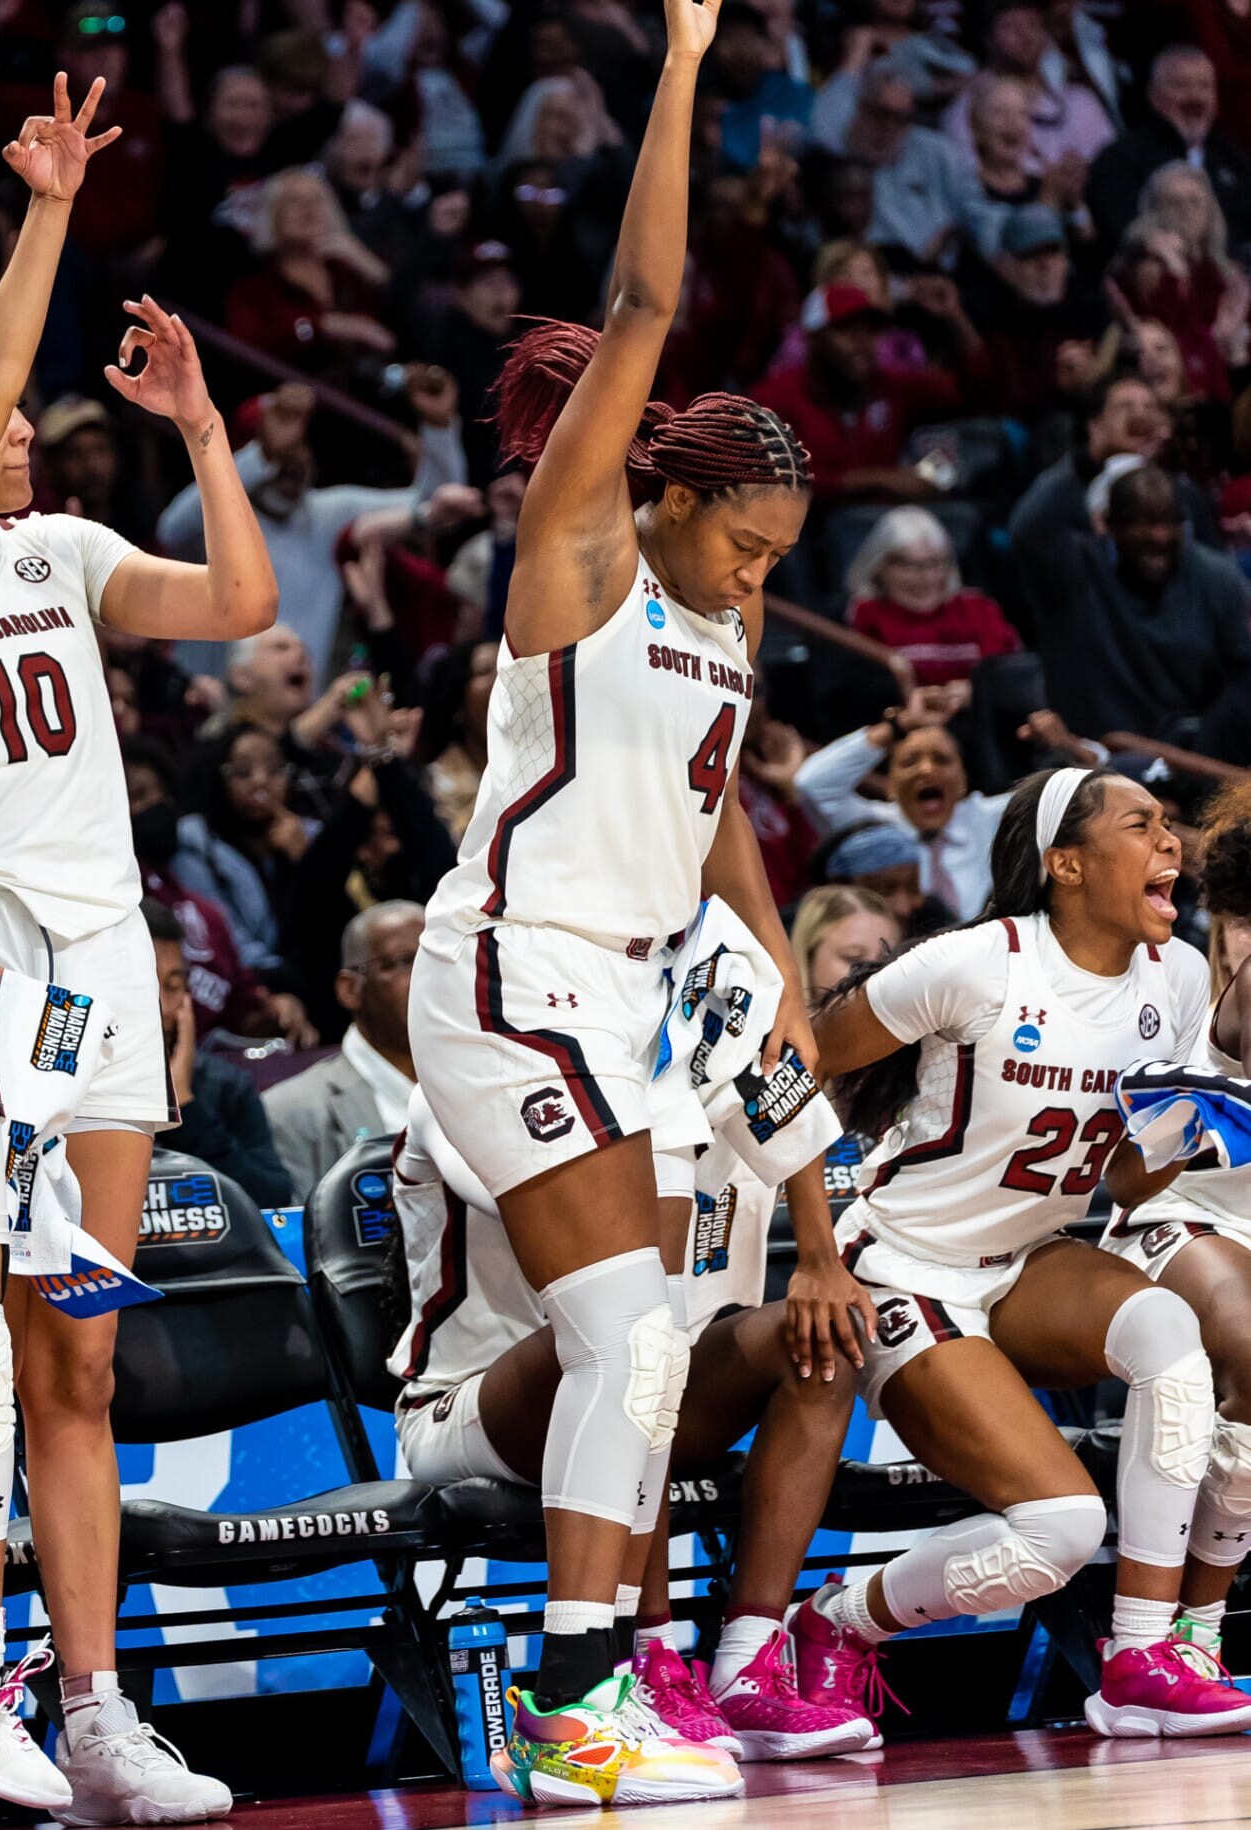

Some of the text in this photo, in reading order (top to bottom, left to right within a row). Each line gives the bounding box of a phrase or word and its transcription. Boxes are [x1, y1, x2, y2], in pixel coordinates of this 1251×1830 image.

[647, 643, 702, 682] SOUTH
[687, 701, 737, 815] 4
[36, 1005, 69, 1072] MADNESS
[60, 1006, 88, 1051] MARCH
[1015, 1035, 1039, 1047] NCAA
[1001, 1058, 1073, 1092] SOUTH
[999, 1106, 1127, 1197] 23
[696, 1212, 715, 1261] MARCH
[217, 1508, 391, 1545] GAMECOCKS
